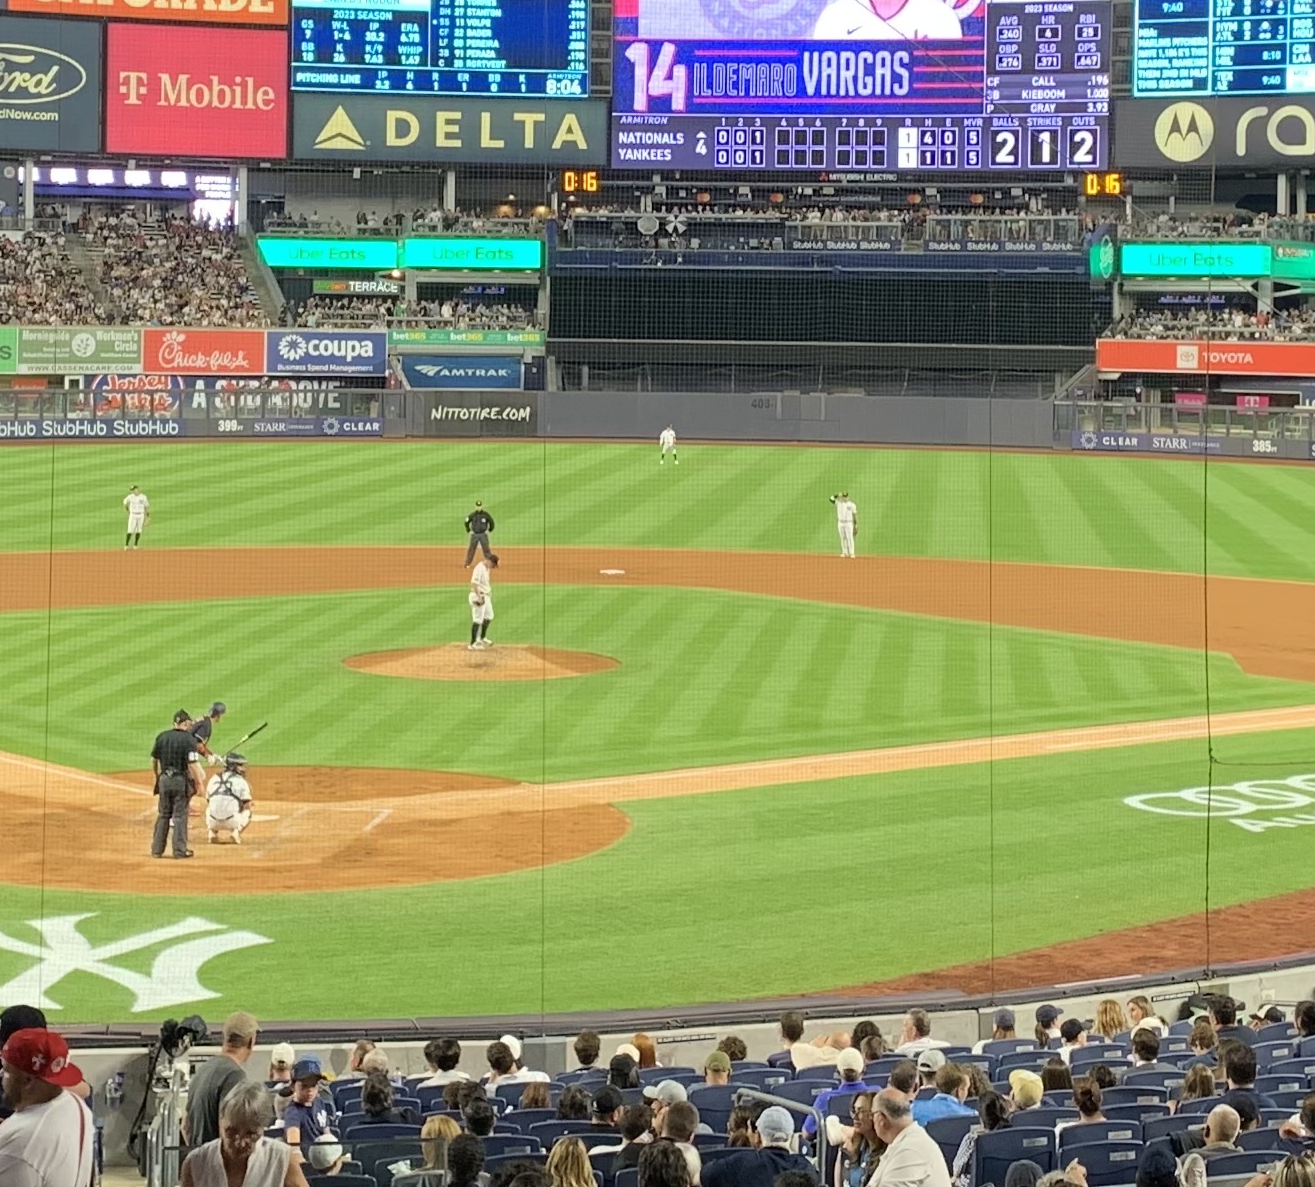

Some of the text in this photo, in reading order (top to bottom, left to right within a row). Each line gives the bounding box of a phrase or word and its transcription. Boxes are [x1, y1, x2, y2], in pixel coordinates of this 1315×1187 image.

[333, 10, 392, 20] 2023 SEASON
[1000, 14, 1096, 25] AVG HR RBI
[297, 72, 361, 84] PITCHING LINE
[625, 41, 910, 112] 14 ILDEMARO VARGAS
[987, 76, 1108, 86] CF CALL .196
[119, 71, 276, 111] T Mobile
[546, 80, 582, 95] 8:04
[620, 116, 668, 125] ARMITRON
[993, 117, 1019, 126] BALLS
[1027, 117, 1062, 126] STRIKES
[1072, 117, 1095, 125] OUTS
[386, 110, 588, 150] DELTA
[995, 130, 1094, 163] 2 1 2
[564, 171, 598, 192] 0:16
[288, 246, 366, 261] Uber Eats
[433, 246, 514, 260] Uber Eats
[348, 280, 398, 293] TERRACE
[96, 330, 138, 342] Workman's
[393, 332, 426, 341] bet365
[450, 332, 483, 341] bet365
[115, 341, 138, 351] Circle
[308, 339, 373, 361] coupa
[159, 340, 249, 368] Chick-fil-A
[1203, 352, 1253, 364] TOYOTA
[307, 364, 327, 372] Spend
[329, 364, 374, 372] Management
[439, 368, 509, 377] AMTRAK
[431, 405, 531, 422] NITTOTIRE.COM
[42, 420, 107, 436] StubHub
[113, 419, 179, 435] StubHub
[254, 422, 286, 432] STARR
[343, 422, 380, 432] CLEAR
[1102, 436, 1138, 447] CLEAR
[1152, 436, 1188, 450] STARR
